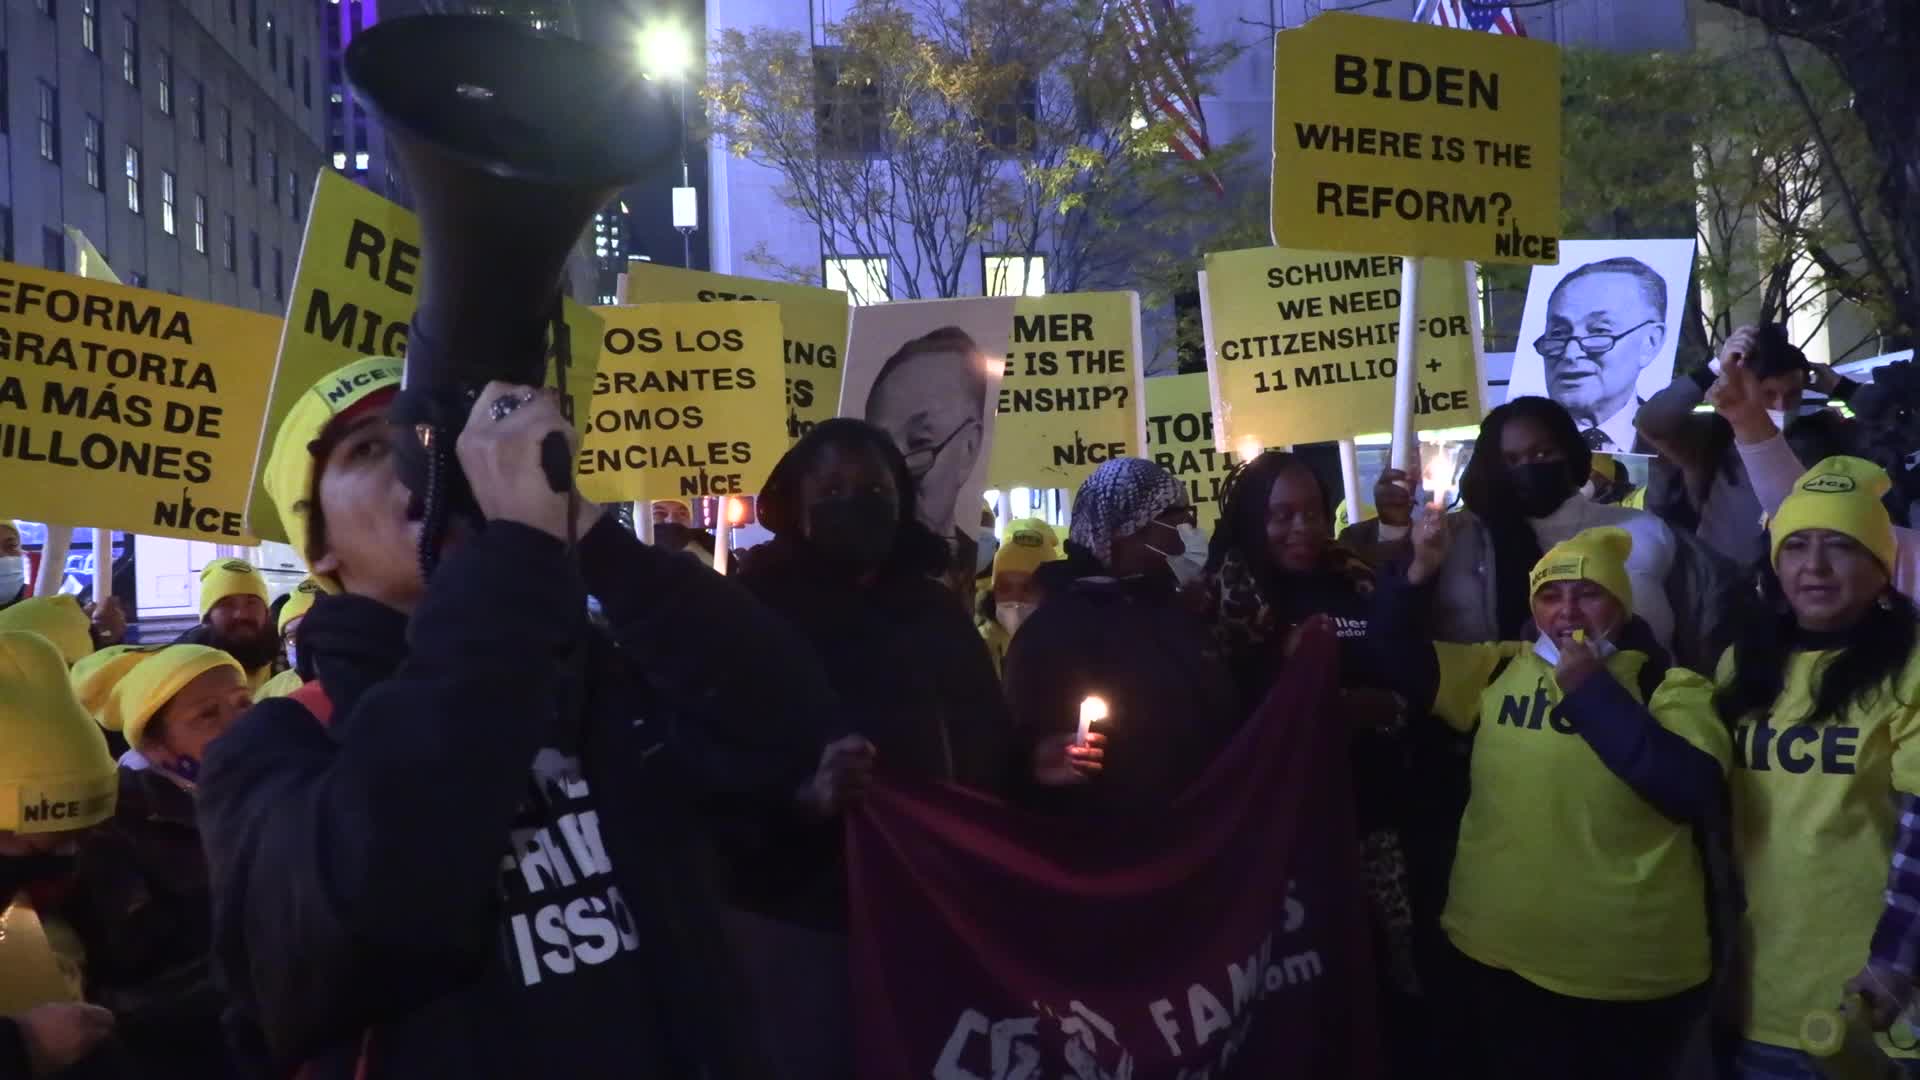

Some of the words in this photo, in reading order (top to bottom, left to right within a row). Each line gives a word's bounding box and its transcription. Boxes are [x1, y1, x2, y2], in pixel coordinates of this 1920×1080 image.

[1335, 54, 1500, 111] BIDEN
[1294, 123, 1422, 159] WHERE
[1431, 135, 1465, 163] IS
[1474, 139, 1532, 169] THE
[1316, 181, 1512, 227] REFORM?
[1495, 217, 1557, 260] NICE
[1267, 256, 1403, 288] SCHUMER
[1277, 296, 1322, 320] WE
[1330, 288, 1401, 315] NEED
[675, 329, 744, 352] LOS
[1013, 314, 1094, 342] MER
[1221, 322, 1400, 361] CITIZENSHIP
[1024, 352, 1058, 376] IS
[1067, 350, 1125, 374] THE
[1254, 370, 1288, 393] 11
[1295, 357, 1398, 388] MILLIO
[592, 367, 756, 395] GRANTES
[42, 382, 152, 428] MÁS
[164, 401, 223, 439] DE
[998, 386, 1129, 413] ENSHIP?
[585, 406, 704, 434] OMOS
[1146, 412, 1214, 445] TO
[0, 424, 212, 483] ILLONES
[577, 441, 752, 474] ENCIALES
[1053, 430, 1126, 466] NICE
[680, 466, 743, 497] NICE
[154, 486, 242, 537] NICE
[24, 793, 80, 821] NICE
